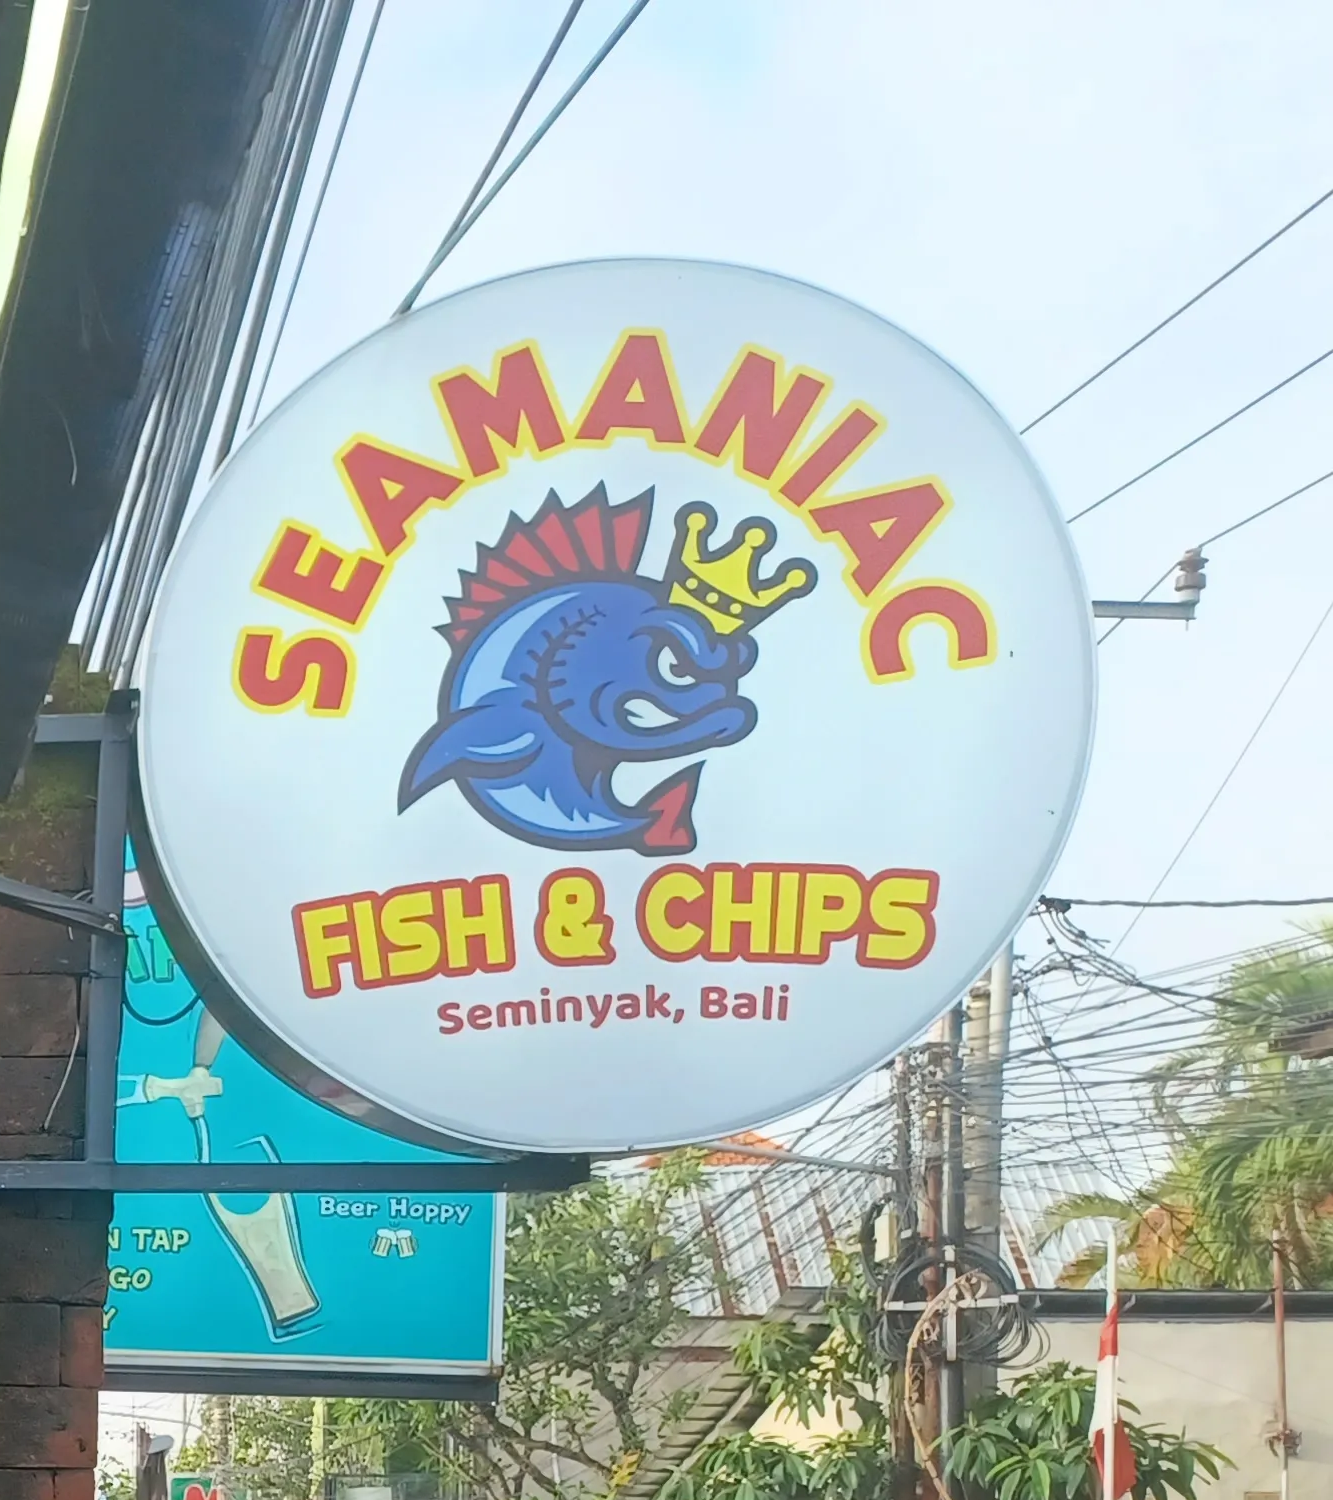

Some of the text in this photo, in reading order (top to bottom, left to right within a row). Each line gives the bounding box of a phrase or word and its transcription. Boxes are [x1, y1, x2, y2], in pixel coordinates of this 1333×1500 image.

[231, 329, 994, 719] SEAMANIAC
[292, 874, 516, 999] FISH
[533, 867, 615, 966] &
[636, 862, 940, 970] CHIPS
[437, 983, 790, 1035] Seminyak, Bali
[319, 1196, 472, 1224] Beer Hoppy
[132, 1227, 191, 1253] TAP
